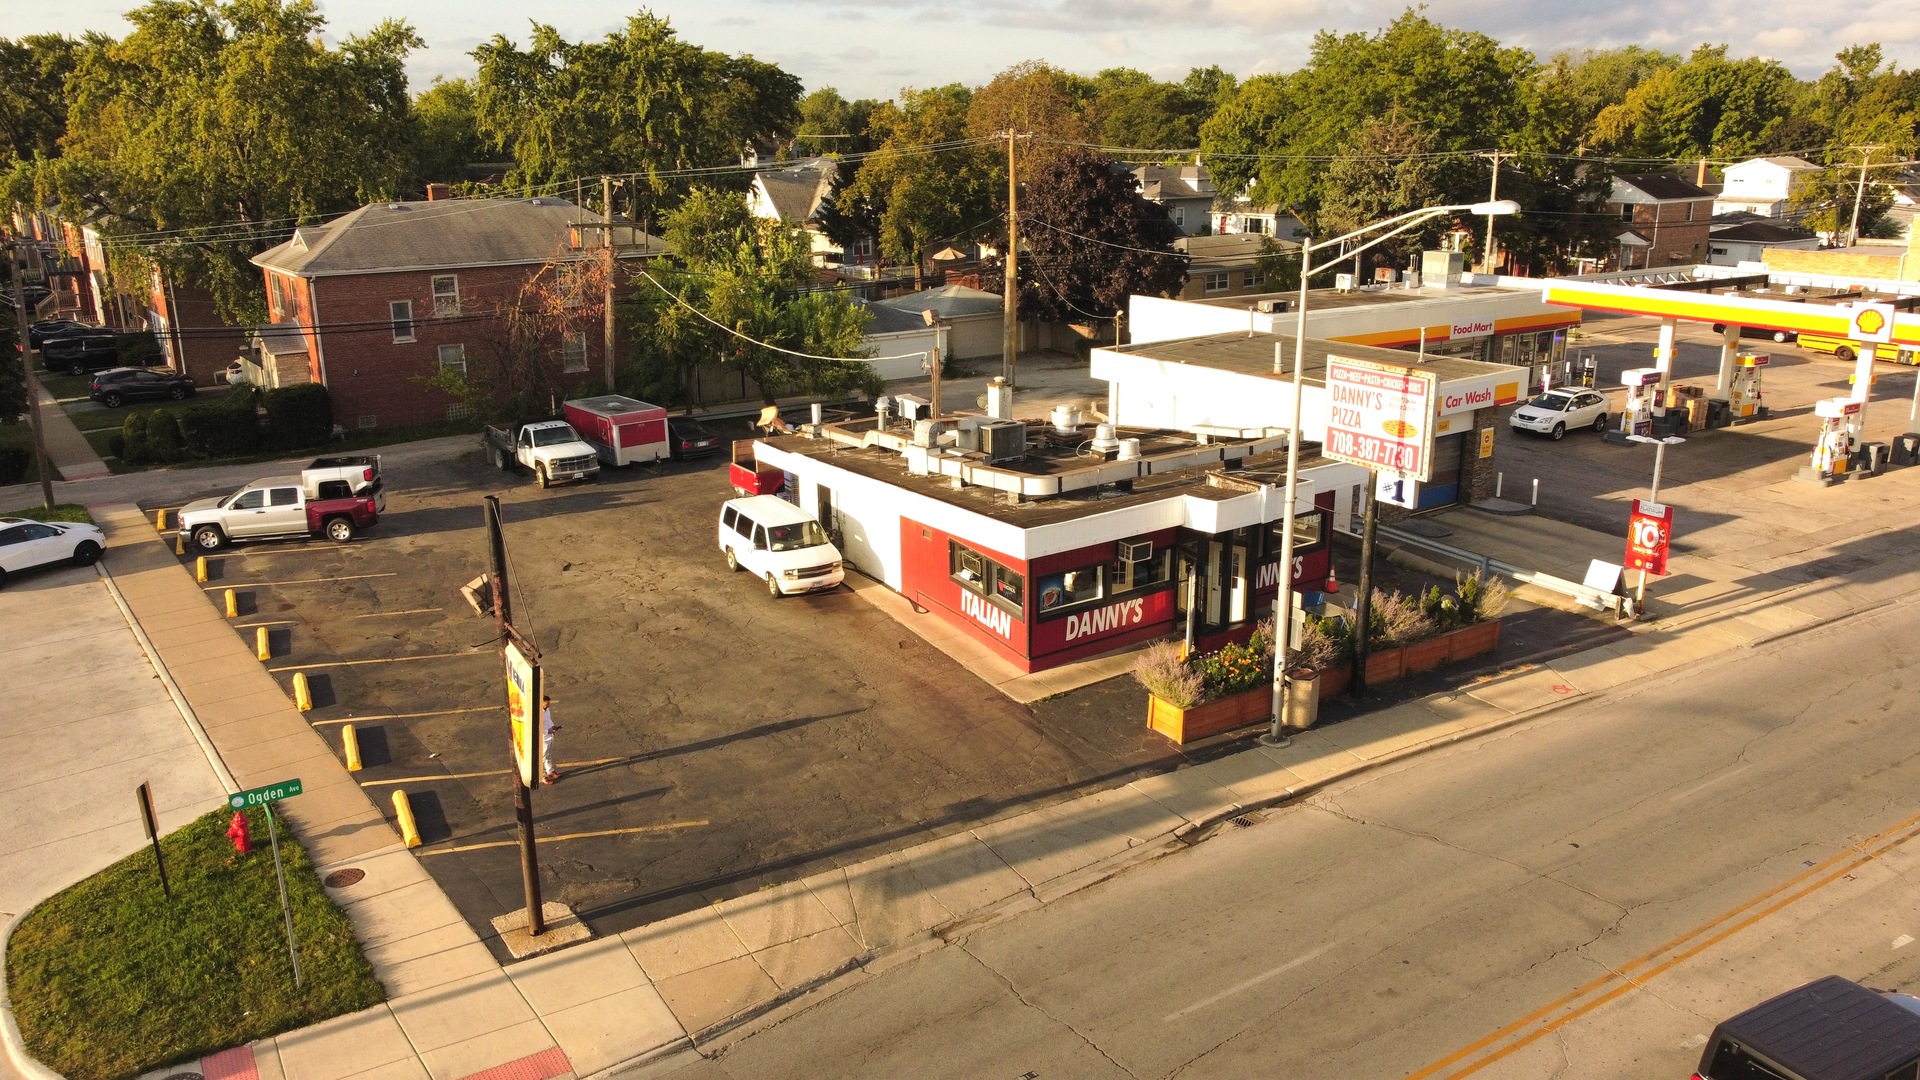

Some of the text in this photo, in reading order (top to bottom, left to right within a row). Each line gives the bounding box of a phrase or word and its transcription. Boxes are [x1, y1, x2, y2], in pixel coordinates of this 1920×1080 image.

[1453, 322, 1492, 335] Food Mart
[1364, 374, 1380, 386] PASTA
[1333, 384, 1382, 410] DANNY'S
[1446, 388, 1491, 409] Car Wash
[1332, 406, 1361, 429] PIZZA
[1332, 430, 1413, 470] 708-387-7730
[961, 588, 1011, 640] ITALIAN
[1066, 598, 1144, 642] DANNY'S
[248, 785, 300, 804] Ogden Ave
